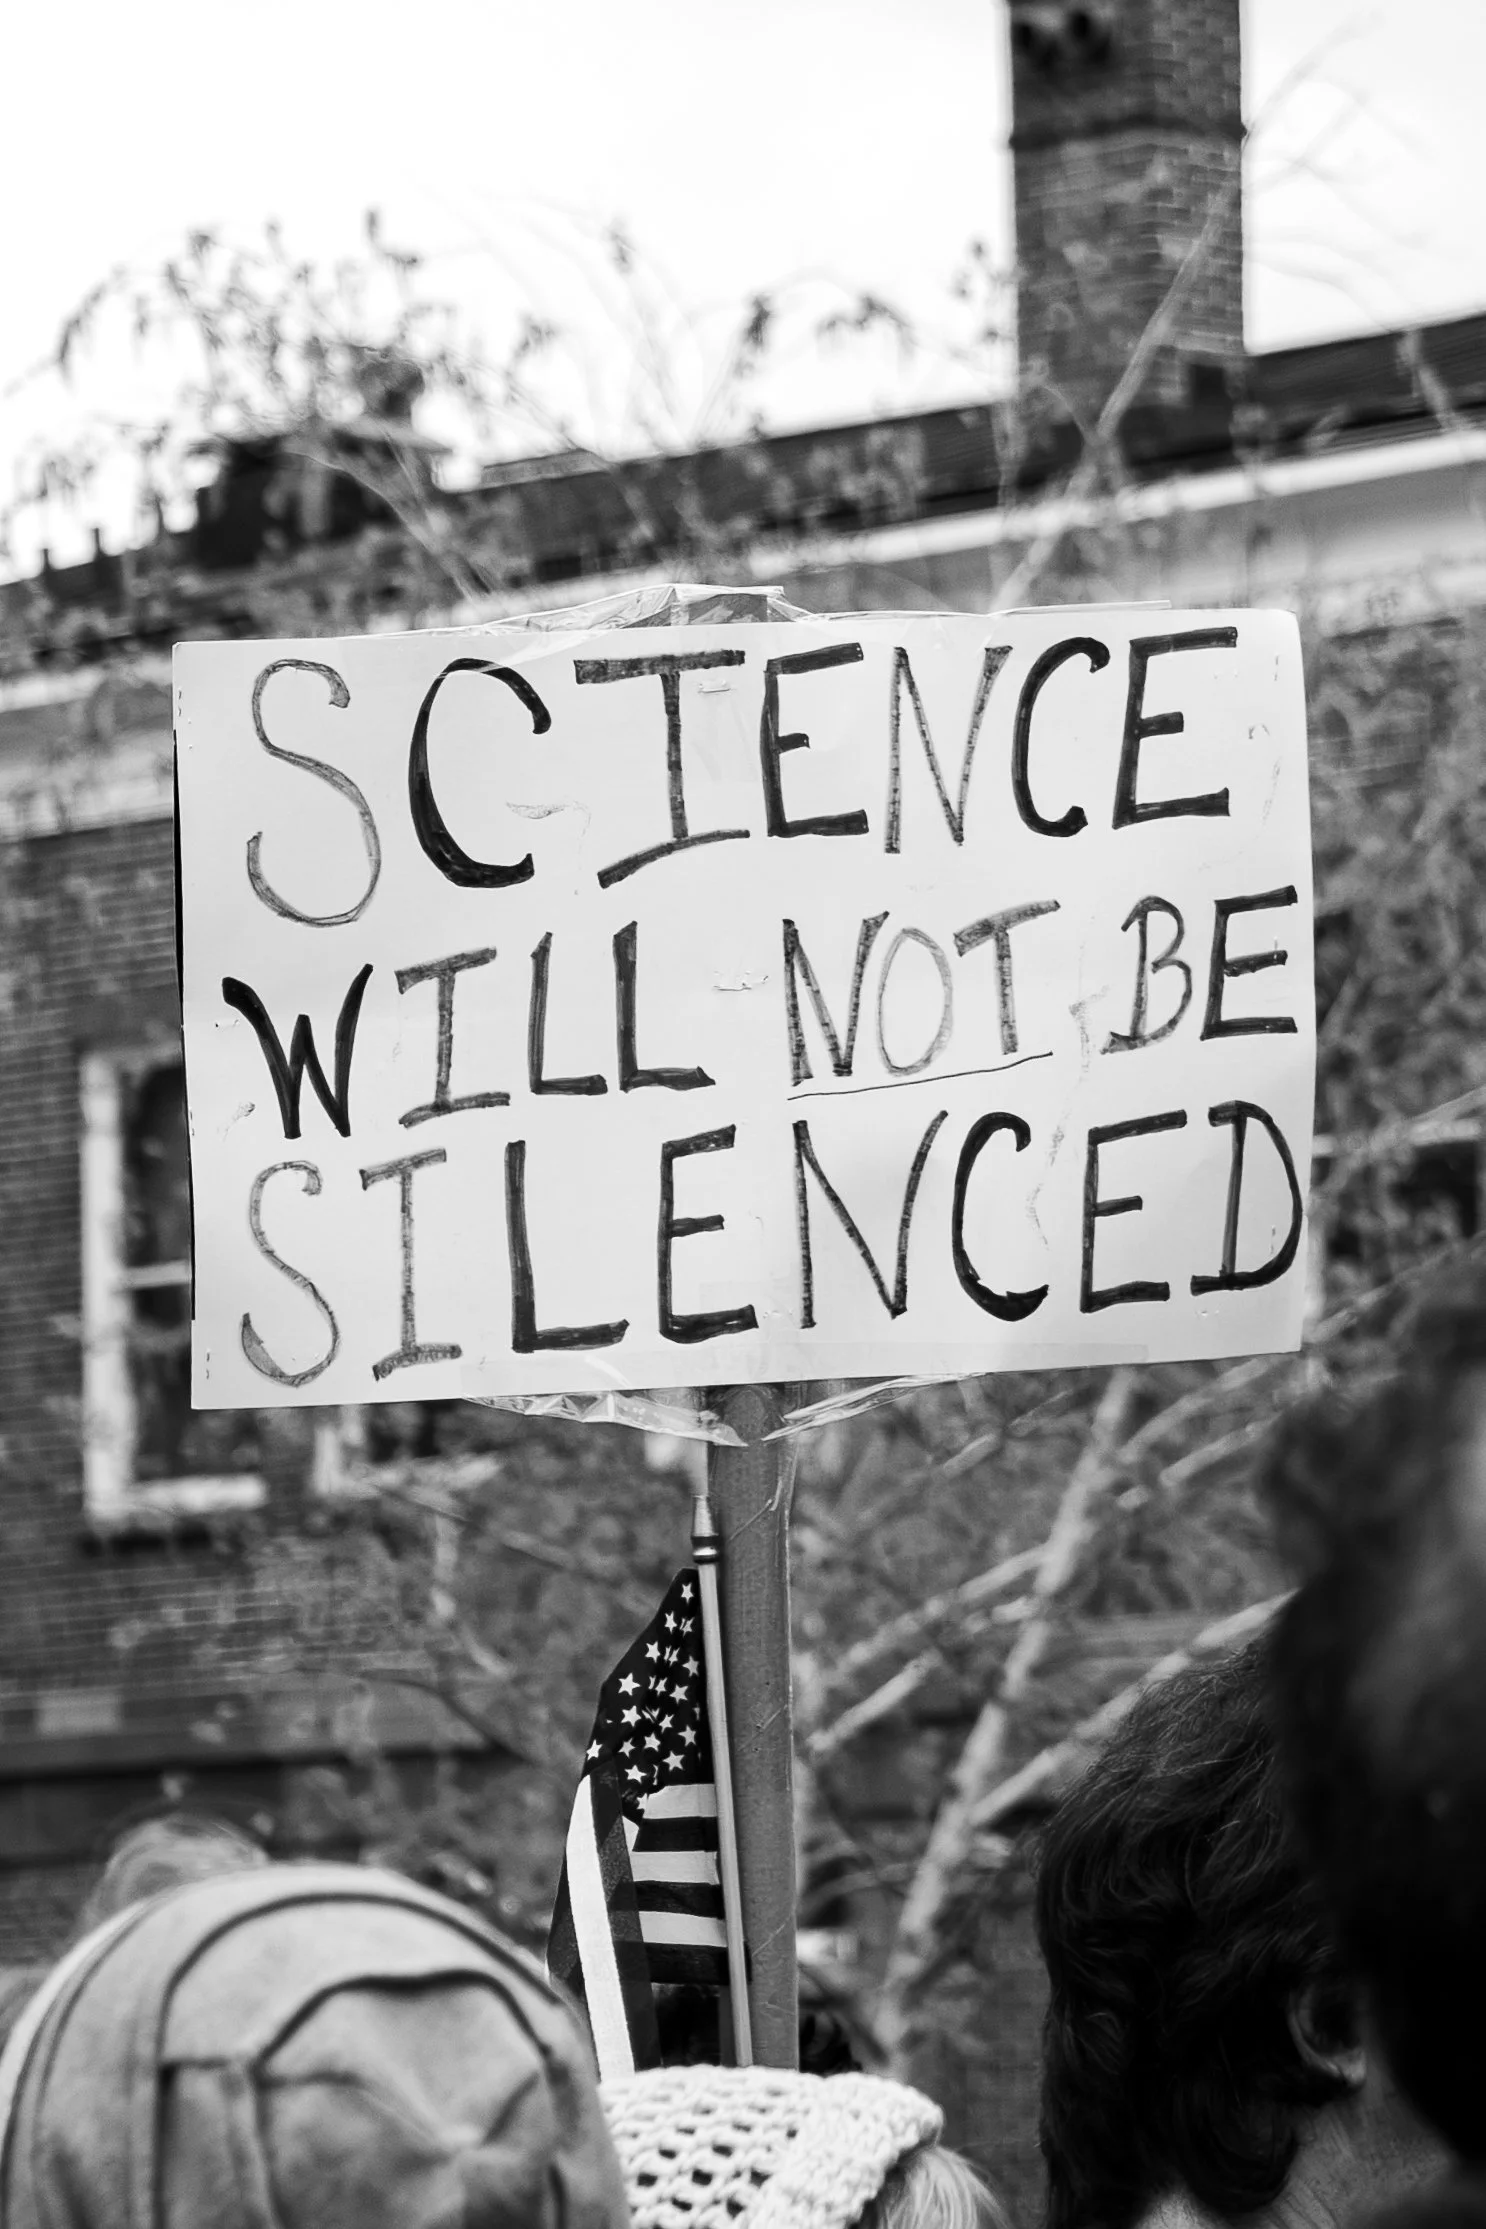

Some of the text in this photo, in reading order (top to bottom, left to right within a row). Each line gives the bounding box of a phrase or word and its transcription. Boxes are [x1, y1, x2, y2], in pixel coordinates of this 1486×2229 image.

[247, 627, 1238, 928] SCIENCE
[222, 885, 1299, 1139] WILL NOT BE
[240, 1100, 1303, 1388] SILENCED
